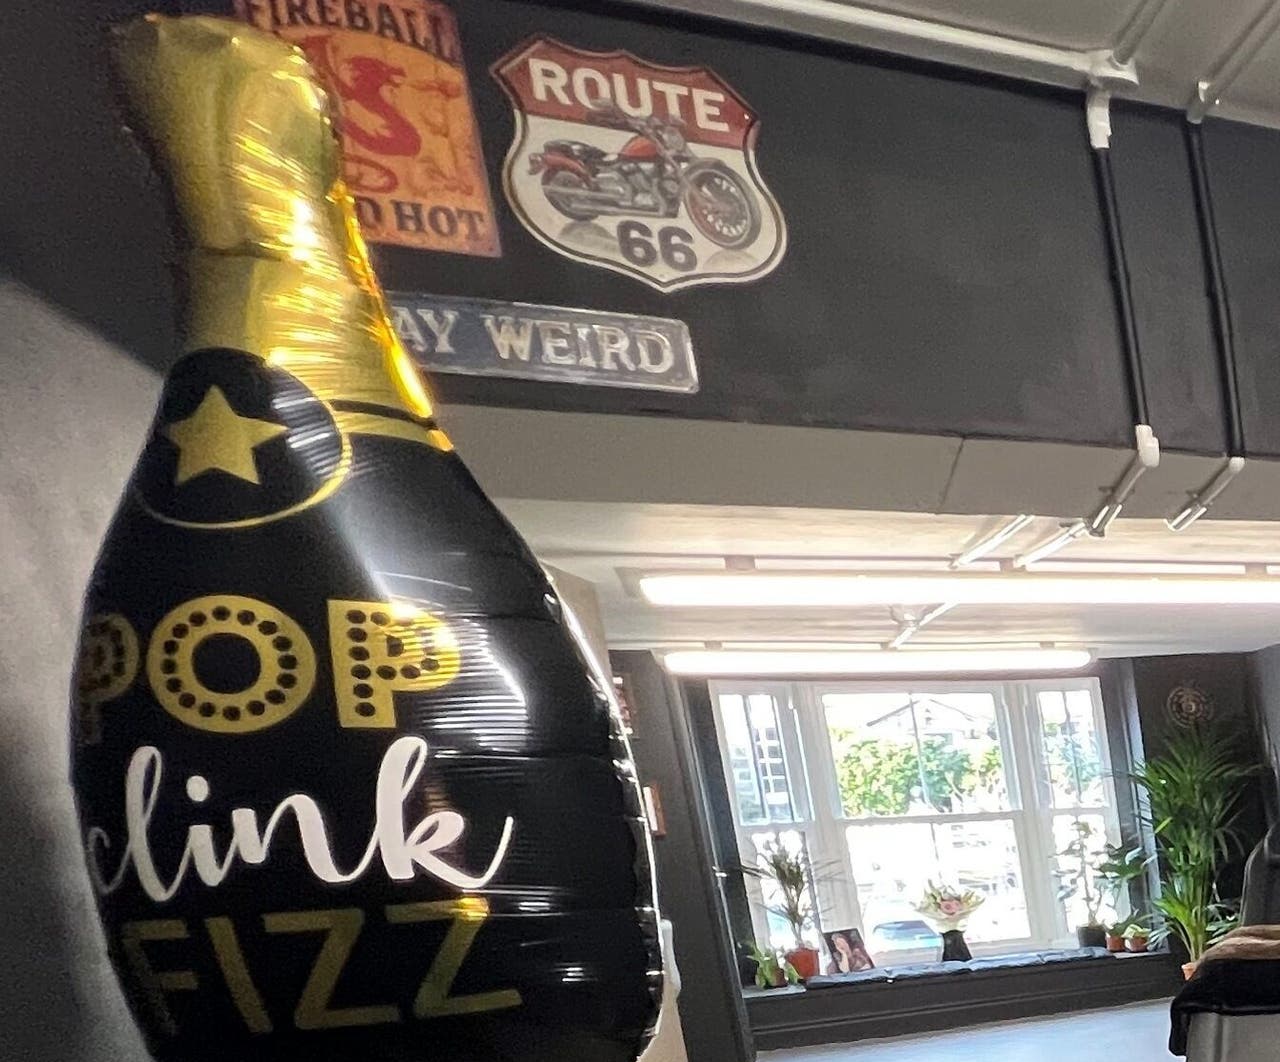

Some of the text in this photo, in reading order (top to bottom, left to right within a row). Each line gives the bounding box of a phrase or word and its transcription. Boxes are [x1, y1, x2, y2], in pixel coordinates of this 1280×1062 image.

[528, 58, 730, 132] ROUTE
[392, 200, 484, 241] HOT
[616, 220, 698, 272] 66
[391, 305, 674, 374] AY WEIRD
[77, 594, 461, 744] POP
[89, 736, 514, 901] clink
[120, 895, 523, 1034] FIZZ
